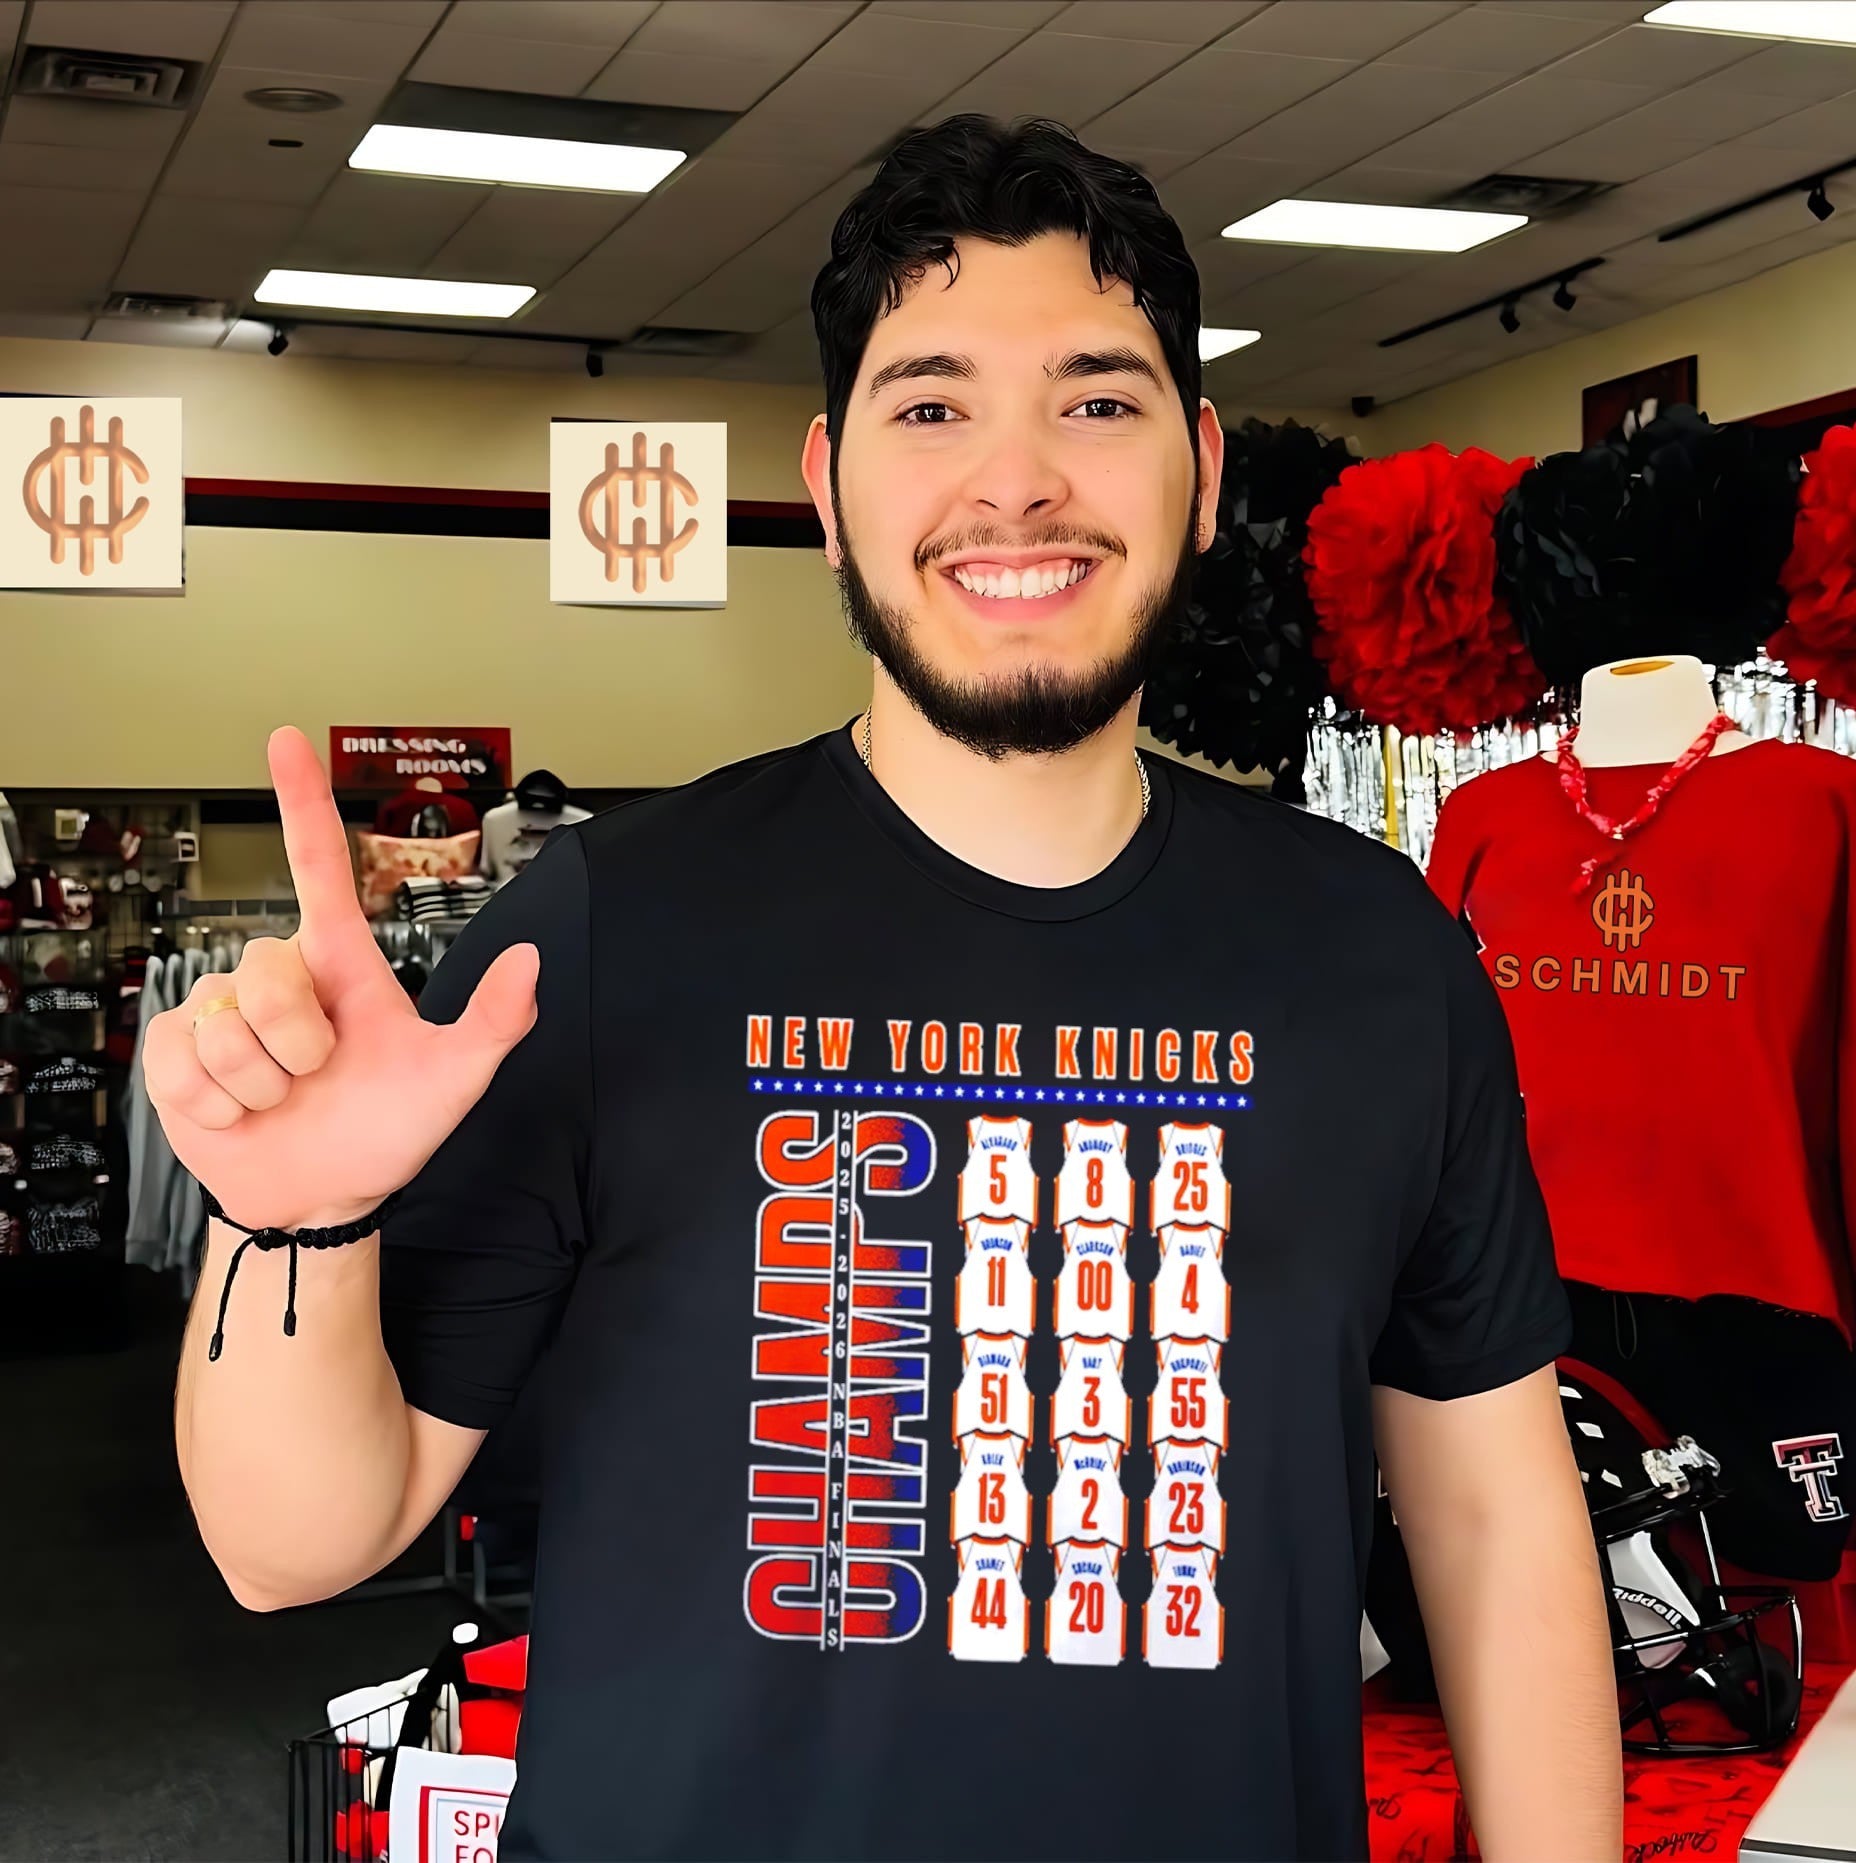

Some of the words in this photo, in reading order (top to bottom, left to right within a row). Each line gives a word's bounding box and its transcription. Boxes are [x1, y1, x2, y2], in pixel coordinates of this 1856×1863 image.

[396, 758, 487, 774] ROOMS
[1494, 953, 1747, 1000] SCHMIDT
[746, 1015, 854, 1070] NEW
[887, 1019, 1022, 1076] YORK
[1055, 1025, 1254, 1084] KNICKS
[989, 1154, 1007, 1205] 5
[1086, 1158, 1104, 1209] 8
[1173, 1161, 1208, 1212] 25
[987, 1256, 1006, 1307] 11
[1077, 1260, 1113, 1311] 00
[1181, 1264, 1199, 1314] 4
[831, 1382, 846, 1459] NBA
[981, 1373, 1008, 1424] 51
[1083, 1376, 1101, 1428] 3
[1171, 1377, 1206, 1429] 55
[978, 1473, 1006, 1525] 13
[1081, 1478, 1099, 1530] 2
[1168, 1481, 1205, 1534] 23
[826, 1482, 843, 1647] FINALS
[971, 1577, 1007, 1629] 44
[1069, 1581, 1105, 1634] 20
[1166, 1585, 1203, 1637] 32
